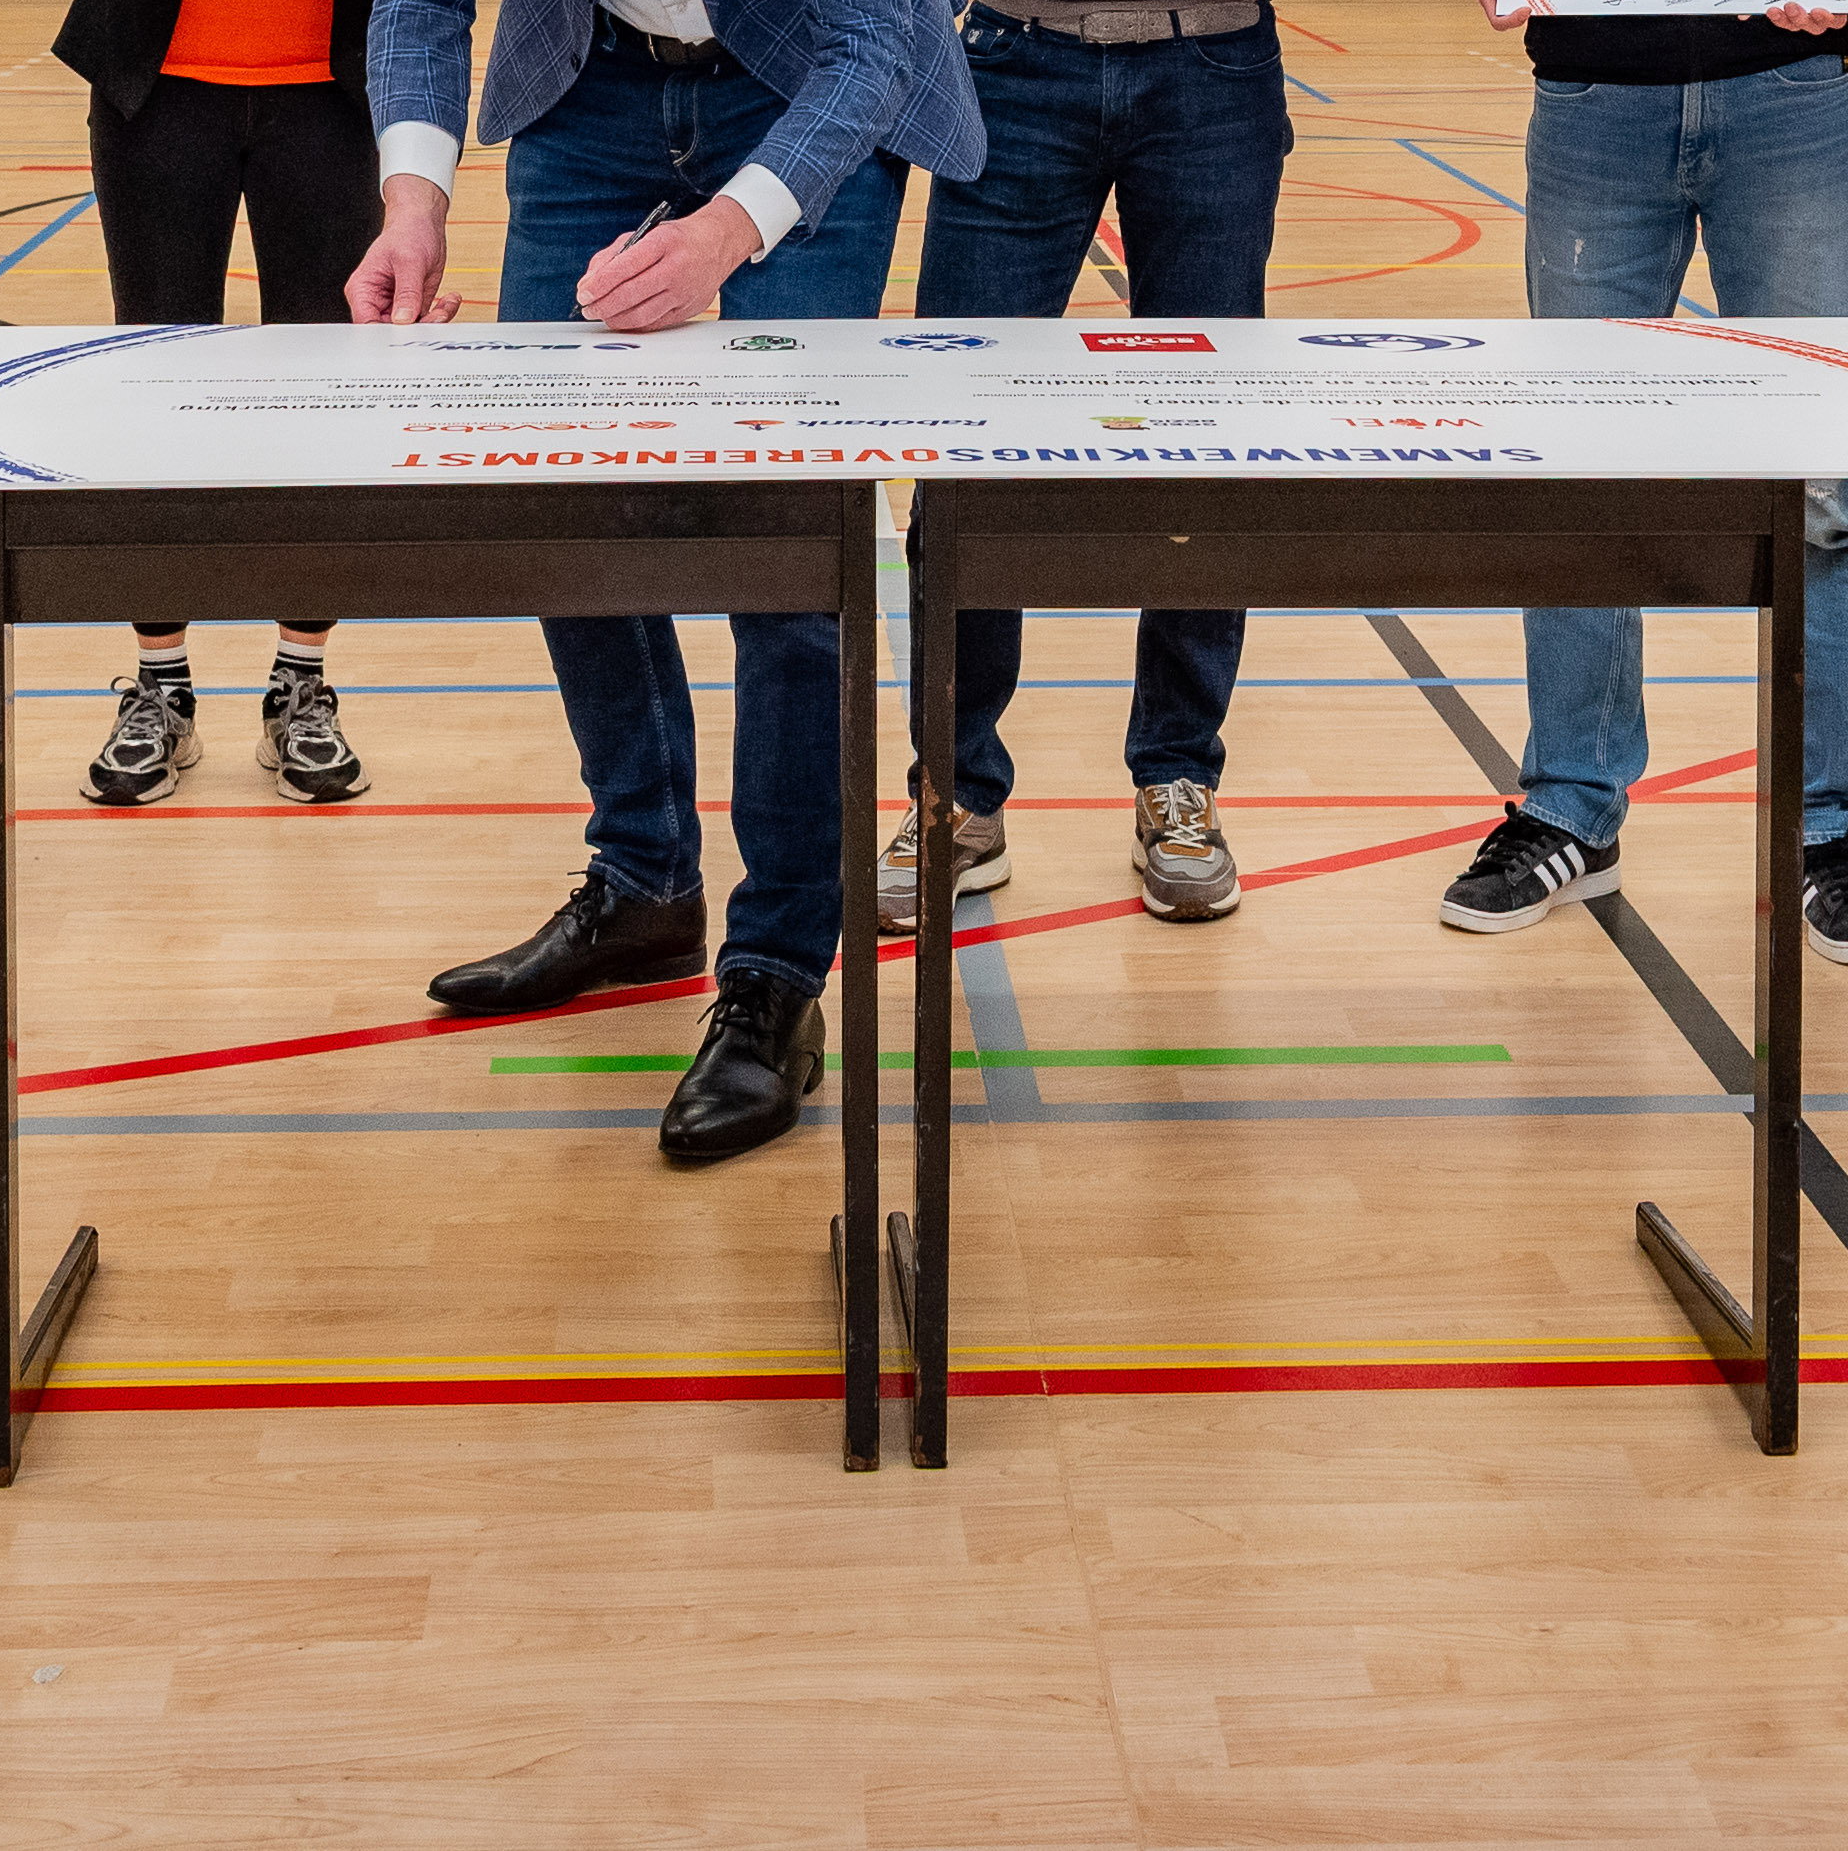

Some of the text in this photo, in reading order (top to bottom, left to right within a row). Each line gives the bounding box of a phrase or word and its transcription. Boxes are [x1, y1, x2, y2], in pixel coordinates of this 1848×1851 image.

[431, 344, 583, 352] BLAUW
[431, 401, 699, 409] volleybalcommunity
[1393, 398, 1679, 406] Trainersontwikkeling
[402, 423, 619, 432] nevobo
[794, 419, 988, 428] Rabobank
[391, 447, 1544, 468] SAMENWERKINGSOVEREENKOMST
